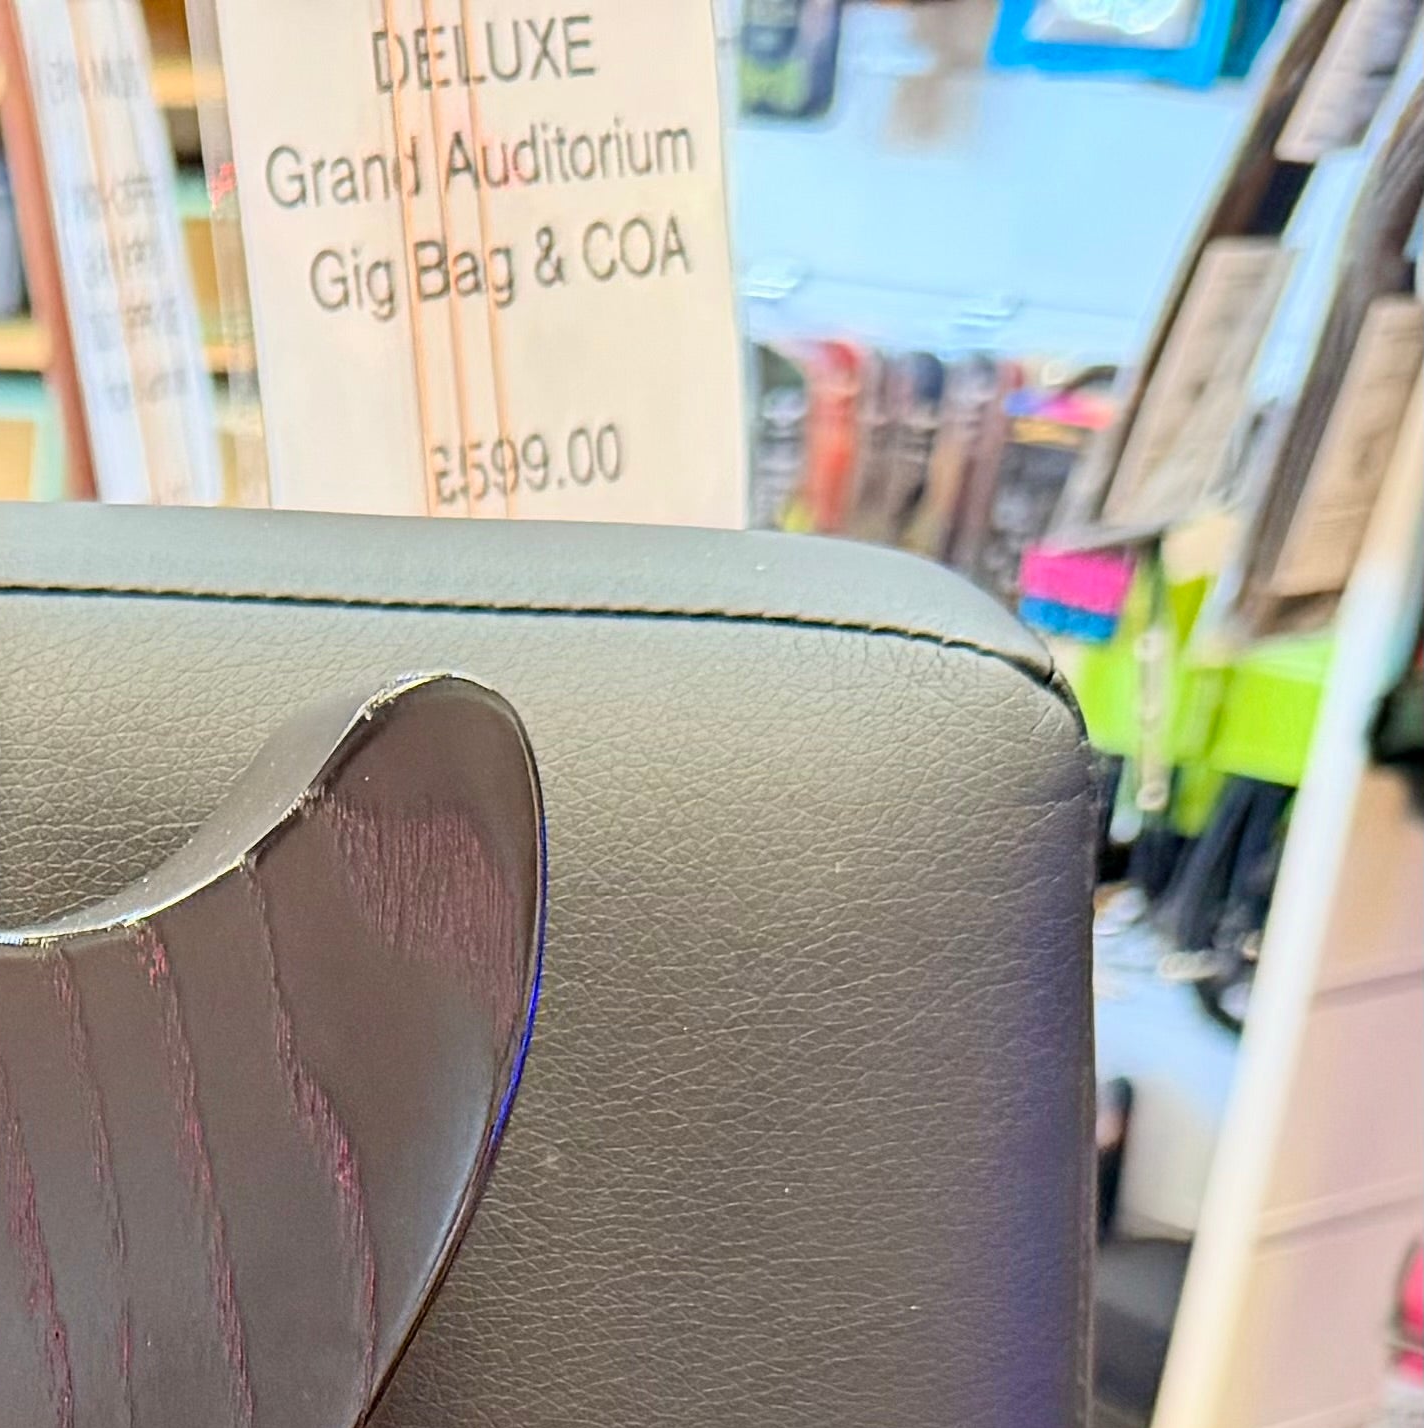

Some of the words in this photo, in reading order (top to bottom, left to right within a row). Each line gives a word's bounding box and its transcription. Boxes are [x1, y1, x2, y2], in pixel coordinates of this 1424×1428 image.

[371, 14, 597, 93] DELUXE
[265, 135, 423, 210] Grand
[444, 117, 697, 194] Auditorium
[309, 246, 396, 323] Gig
[413, 238, 515, 309] Bag
[533, 225, 568, 288] &
[582, 211, 692, 283] COA
